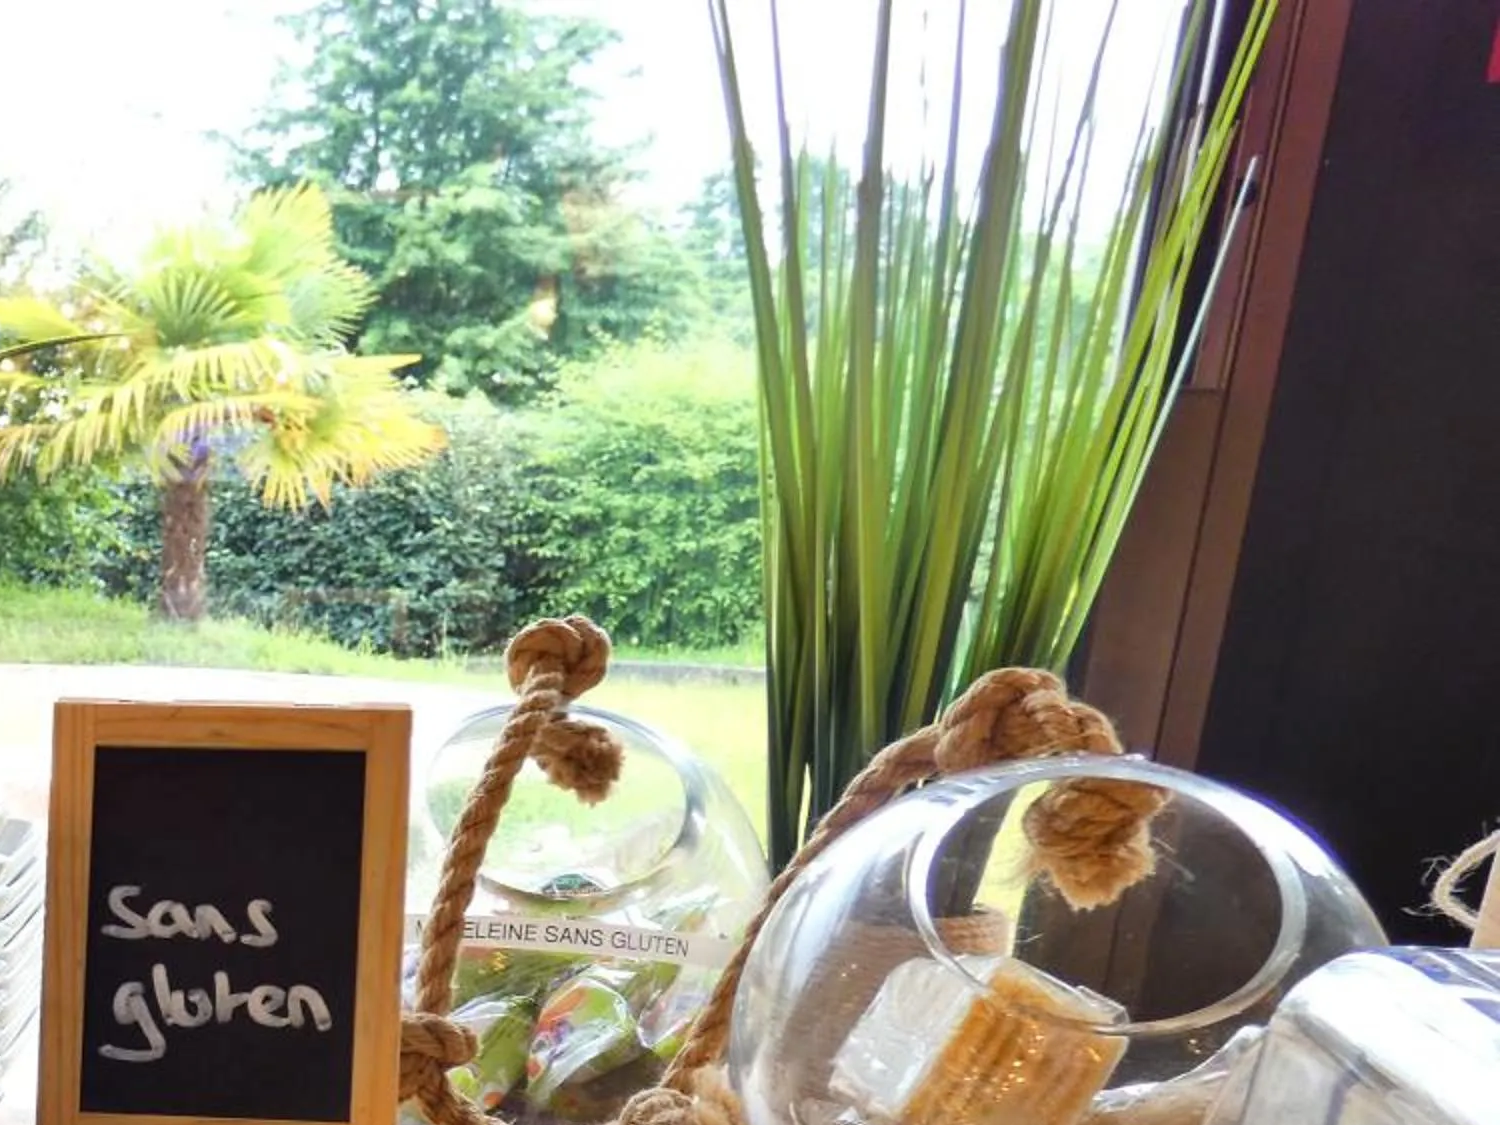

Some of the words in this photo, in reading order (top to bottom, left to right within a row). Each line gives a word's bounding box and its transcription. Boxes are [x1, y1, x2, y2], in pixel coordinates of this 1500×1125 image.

[416, 919, 536, 942] ELEINE
[544, 925, 604, 947] SANS
[611, 931, 688, 956] GLUTEN
